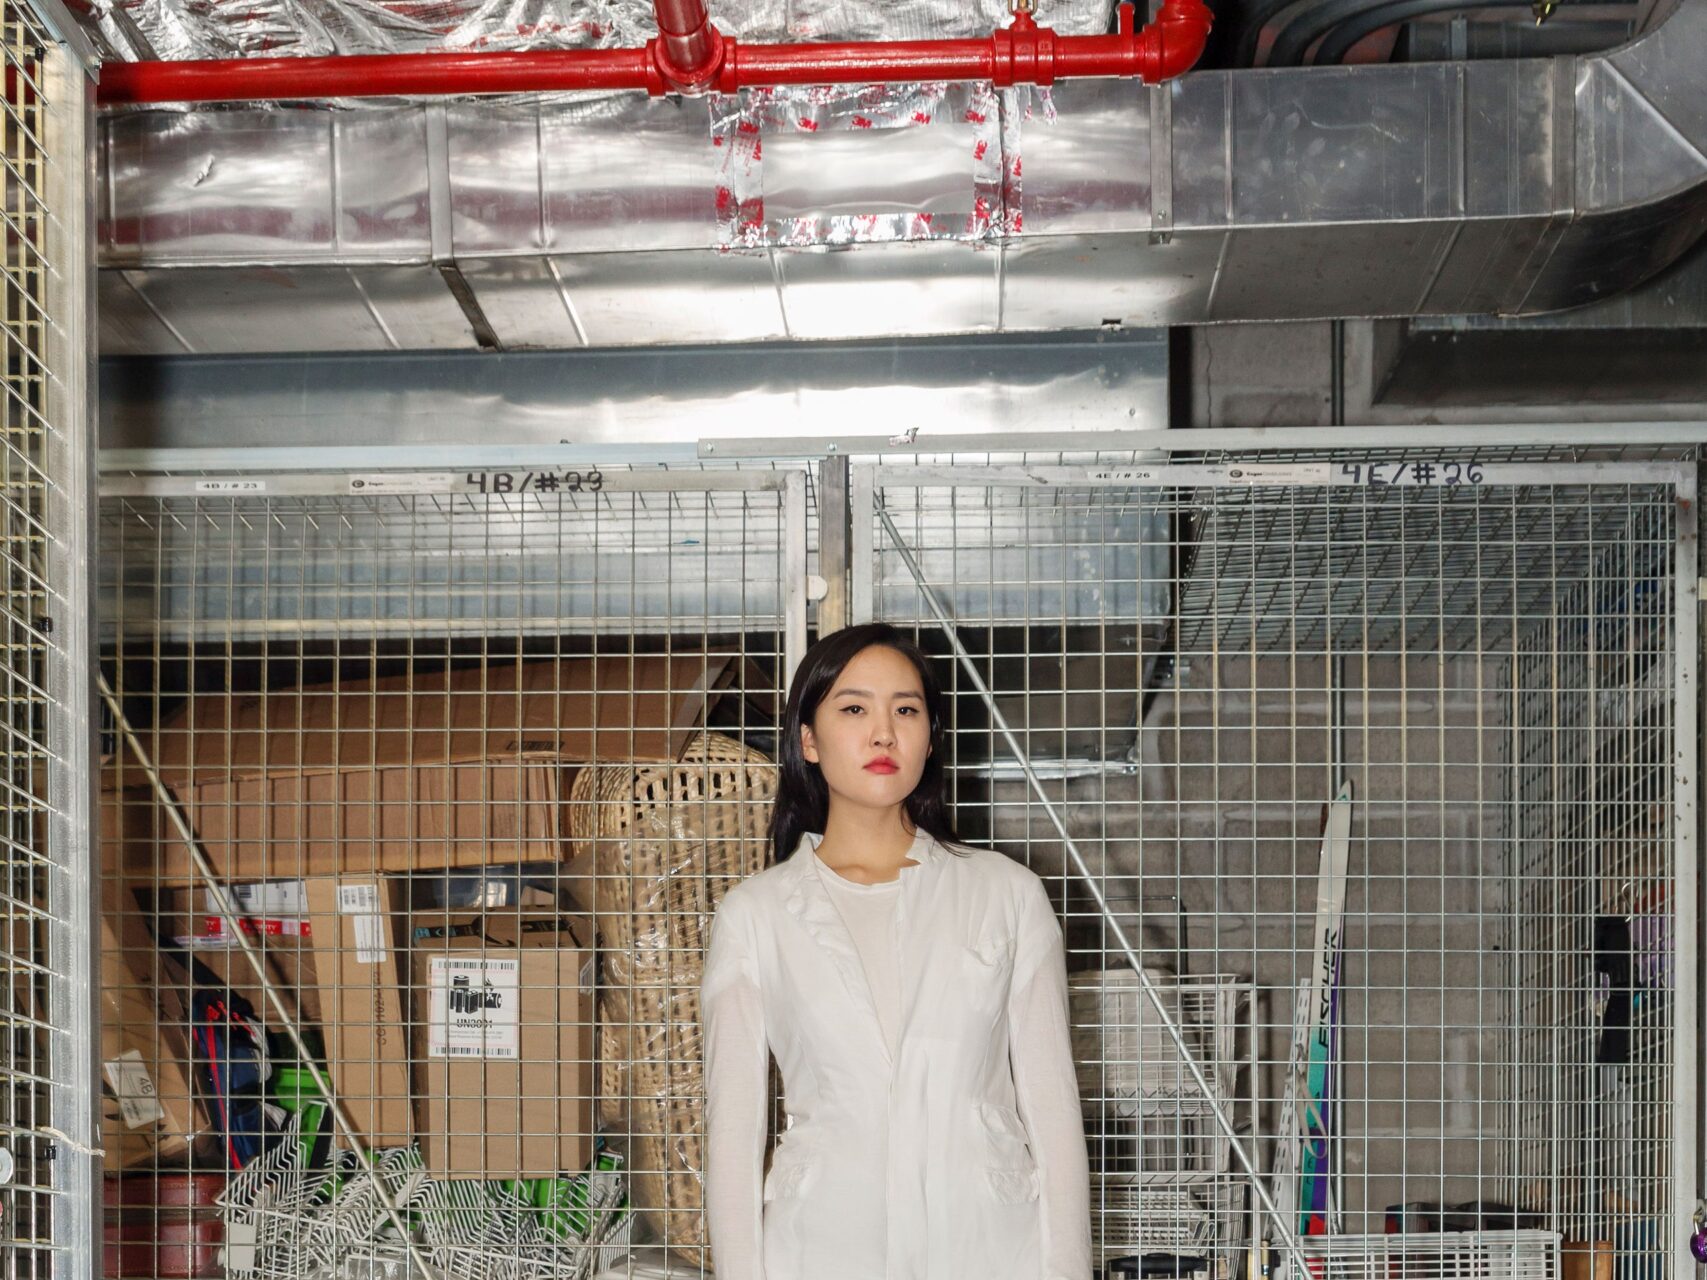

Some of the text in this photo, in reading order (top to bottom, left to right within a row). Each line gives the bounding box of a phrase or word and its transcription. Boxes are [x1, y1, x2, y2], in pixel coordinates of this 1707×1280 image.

[798, 117, 819, 133] 3M
[852, 115, 873, 129] 3M
[911, 111, 932, 125] 3M
[965, 110, 986, 125] 3M
[973, 139, 988, 161] 3M
[1318, 927, 1338, 1049] FISCHER
